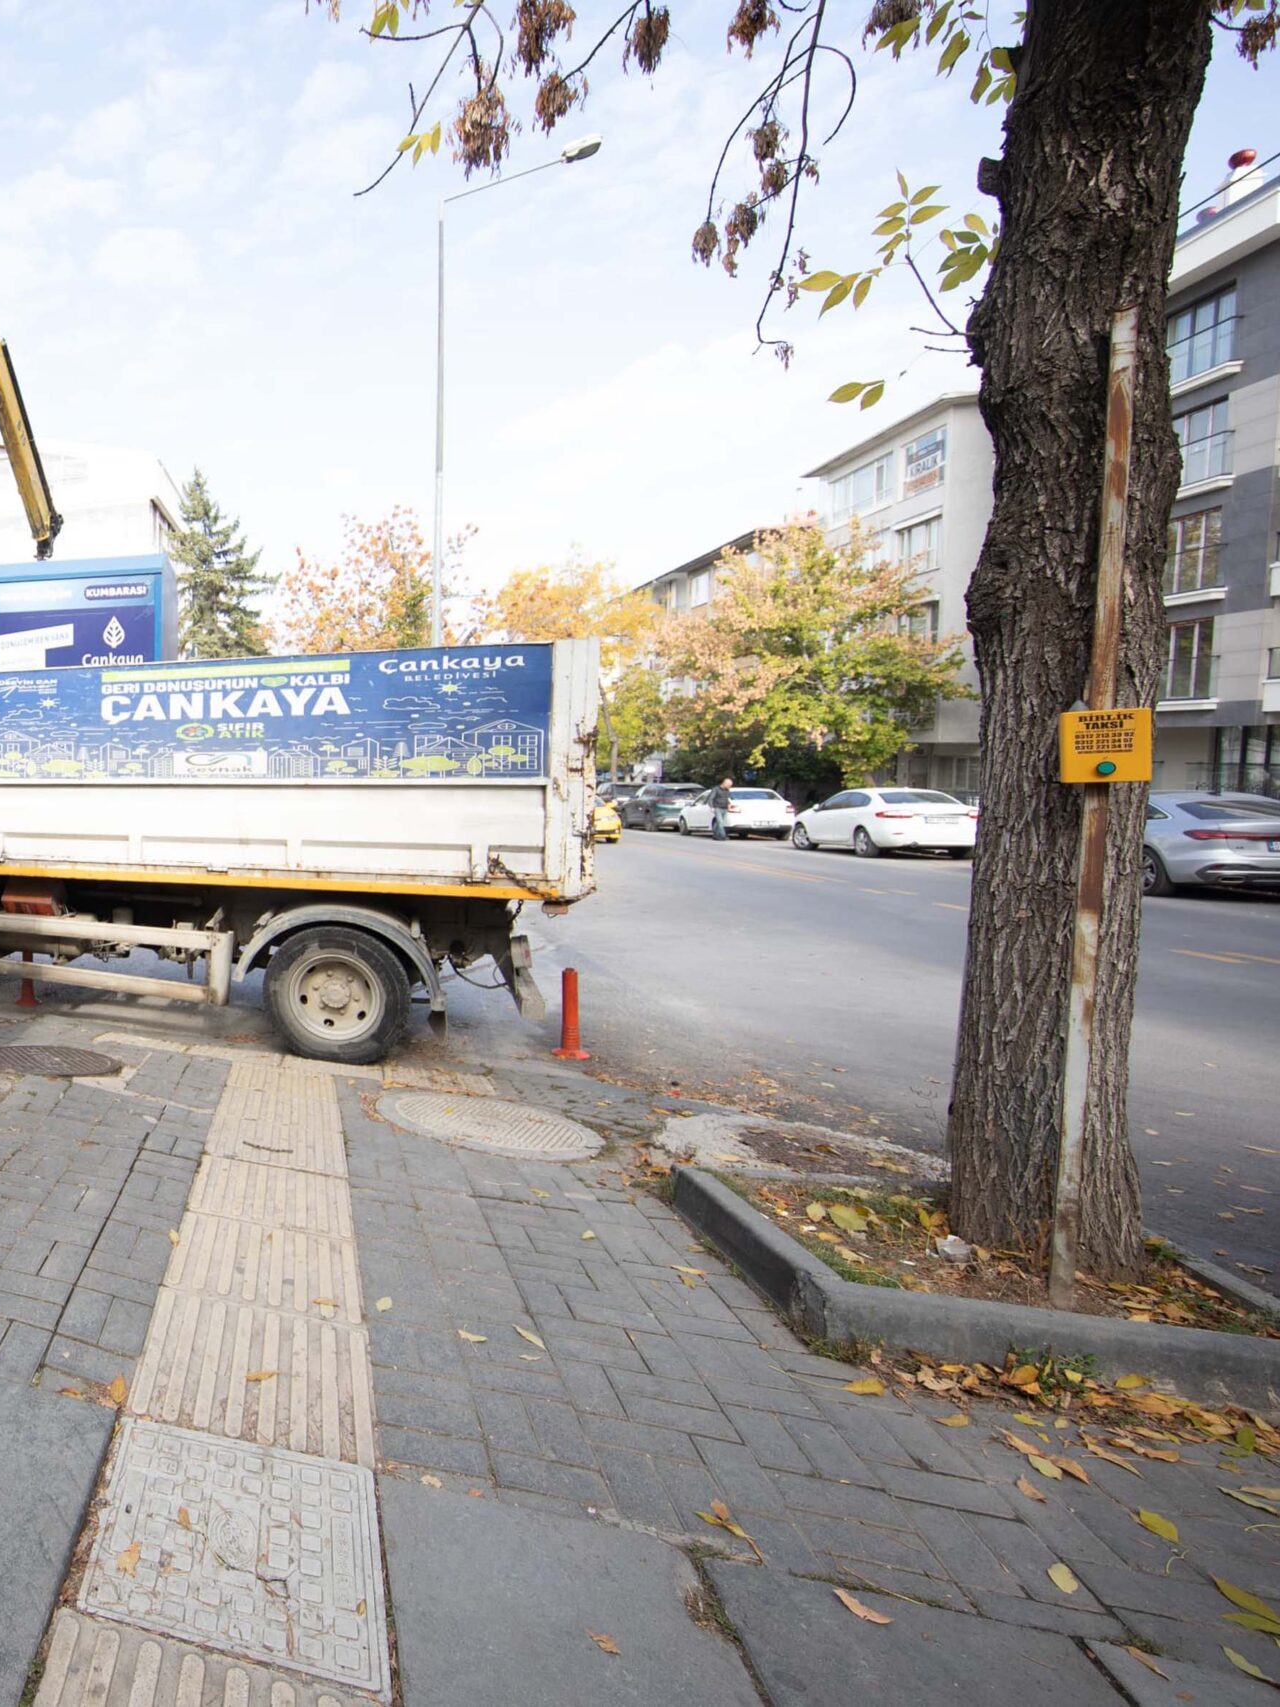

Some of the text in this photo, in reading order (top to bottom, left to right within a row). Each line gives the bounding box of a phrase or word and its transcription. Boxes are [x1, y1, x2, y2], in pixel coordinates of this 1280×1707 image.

[85, 585, 147, 598] KUMBARASI
[378, 655, 526, 675] Çankaya
[404, 671, 497, 682] BELEDİYESİ
[101, 686, 352, 725] ÇANKAYA
[1078, 713, 1135, 722] BİRLİK
[217, 722, 265, 731] SIFIR
[1083, 720, 1124, 729] TAKSİ
[218, 730, 265, 739] ATIK
